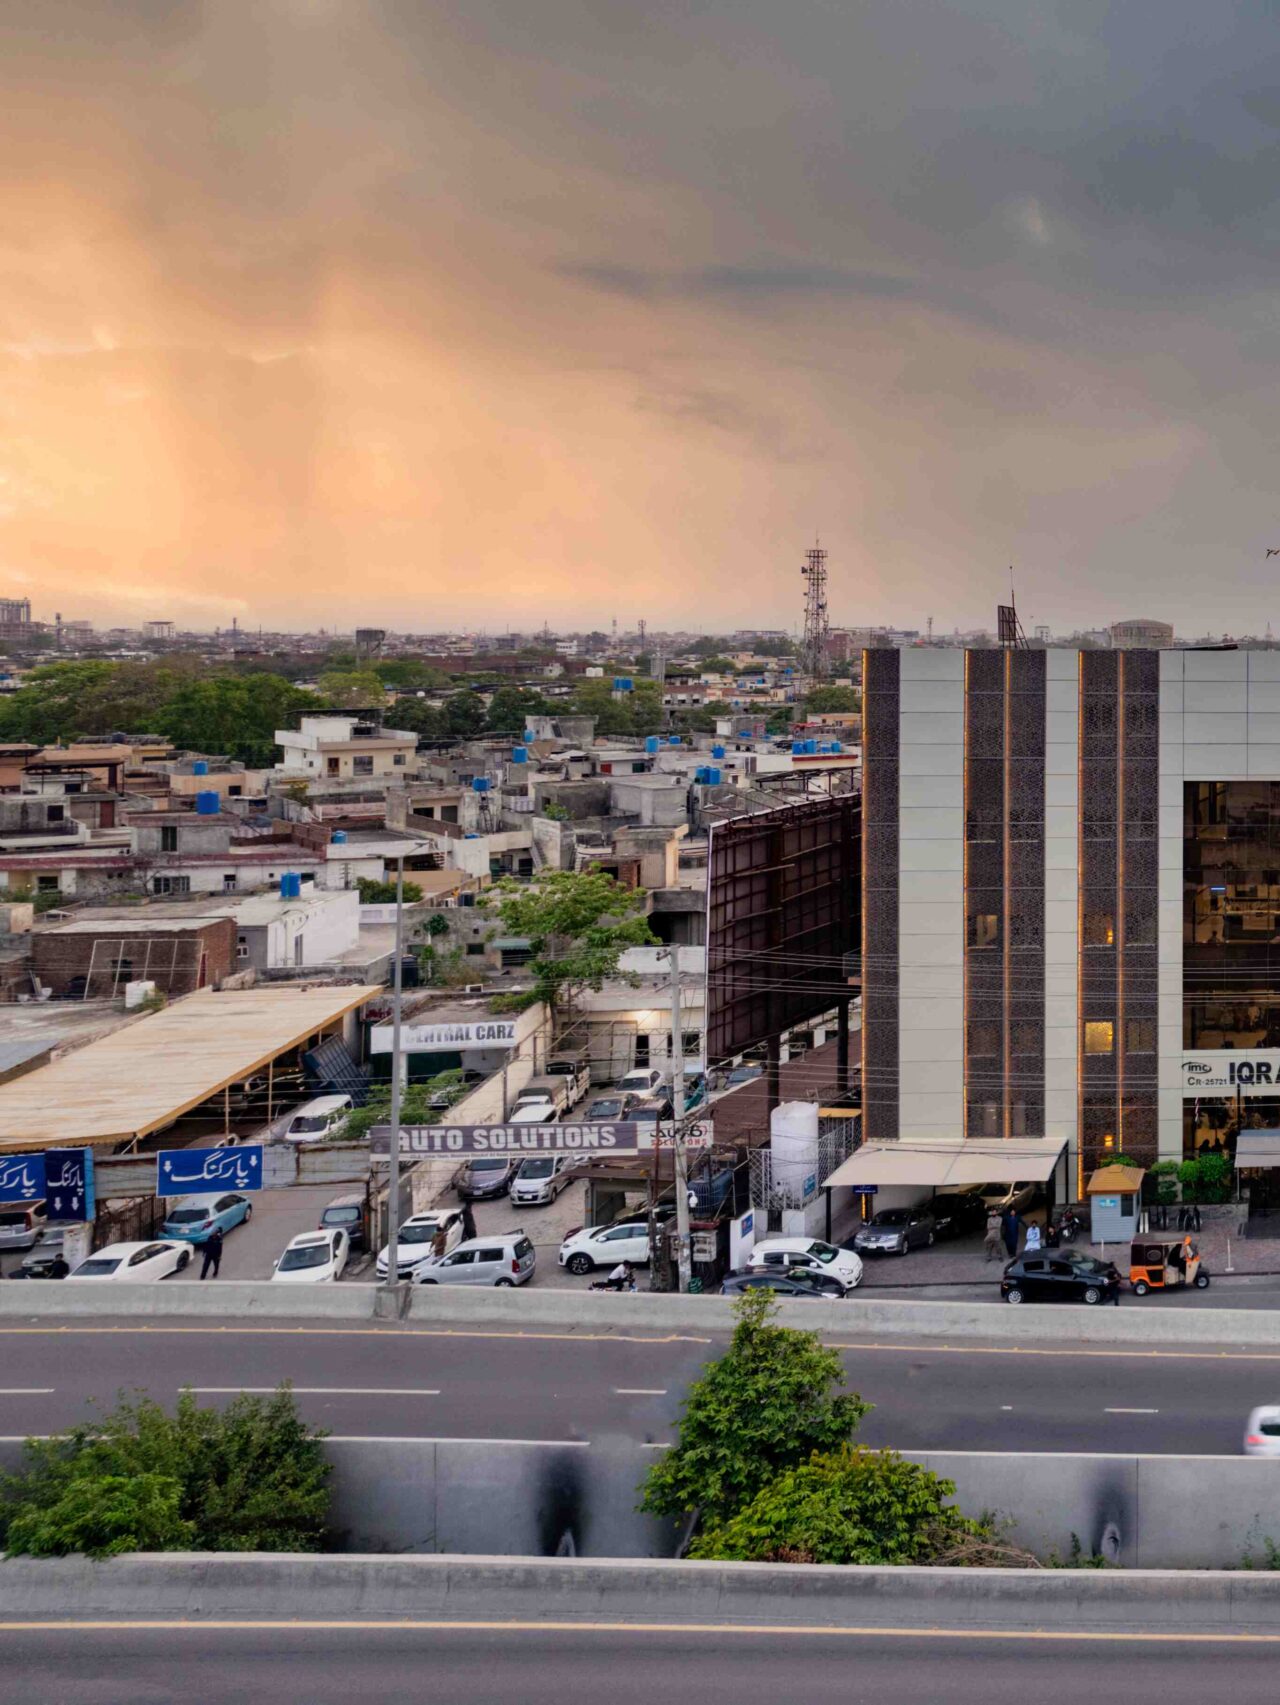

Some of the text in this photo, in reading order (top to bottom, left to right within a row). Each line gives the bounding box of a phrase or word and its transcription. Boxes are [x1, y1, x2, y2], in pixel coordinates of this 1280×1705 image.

[476, 1024, 515, 1041] CARZ
[399, 1126, 616, 1151] AUTO SOLUTIONS
[47, 1160, 84, 1196] پارکنگ
[170, 1150, 249, 1188] پارکنگ
